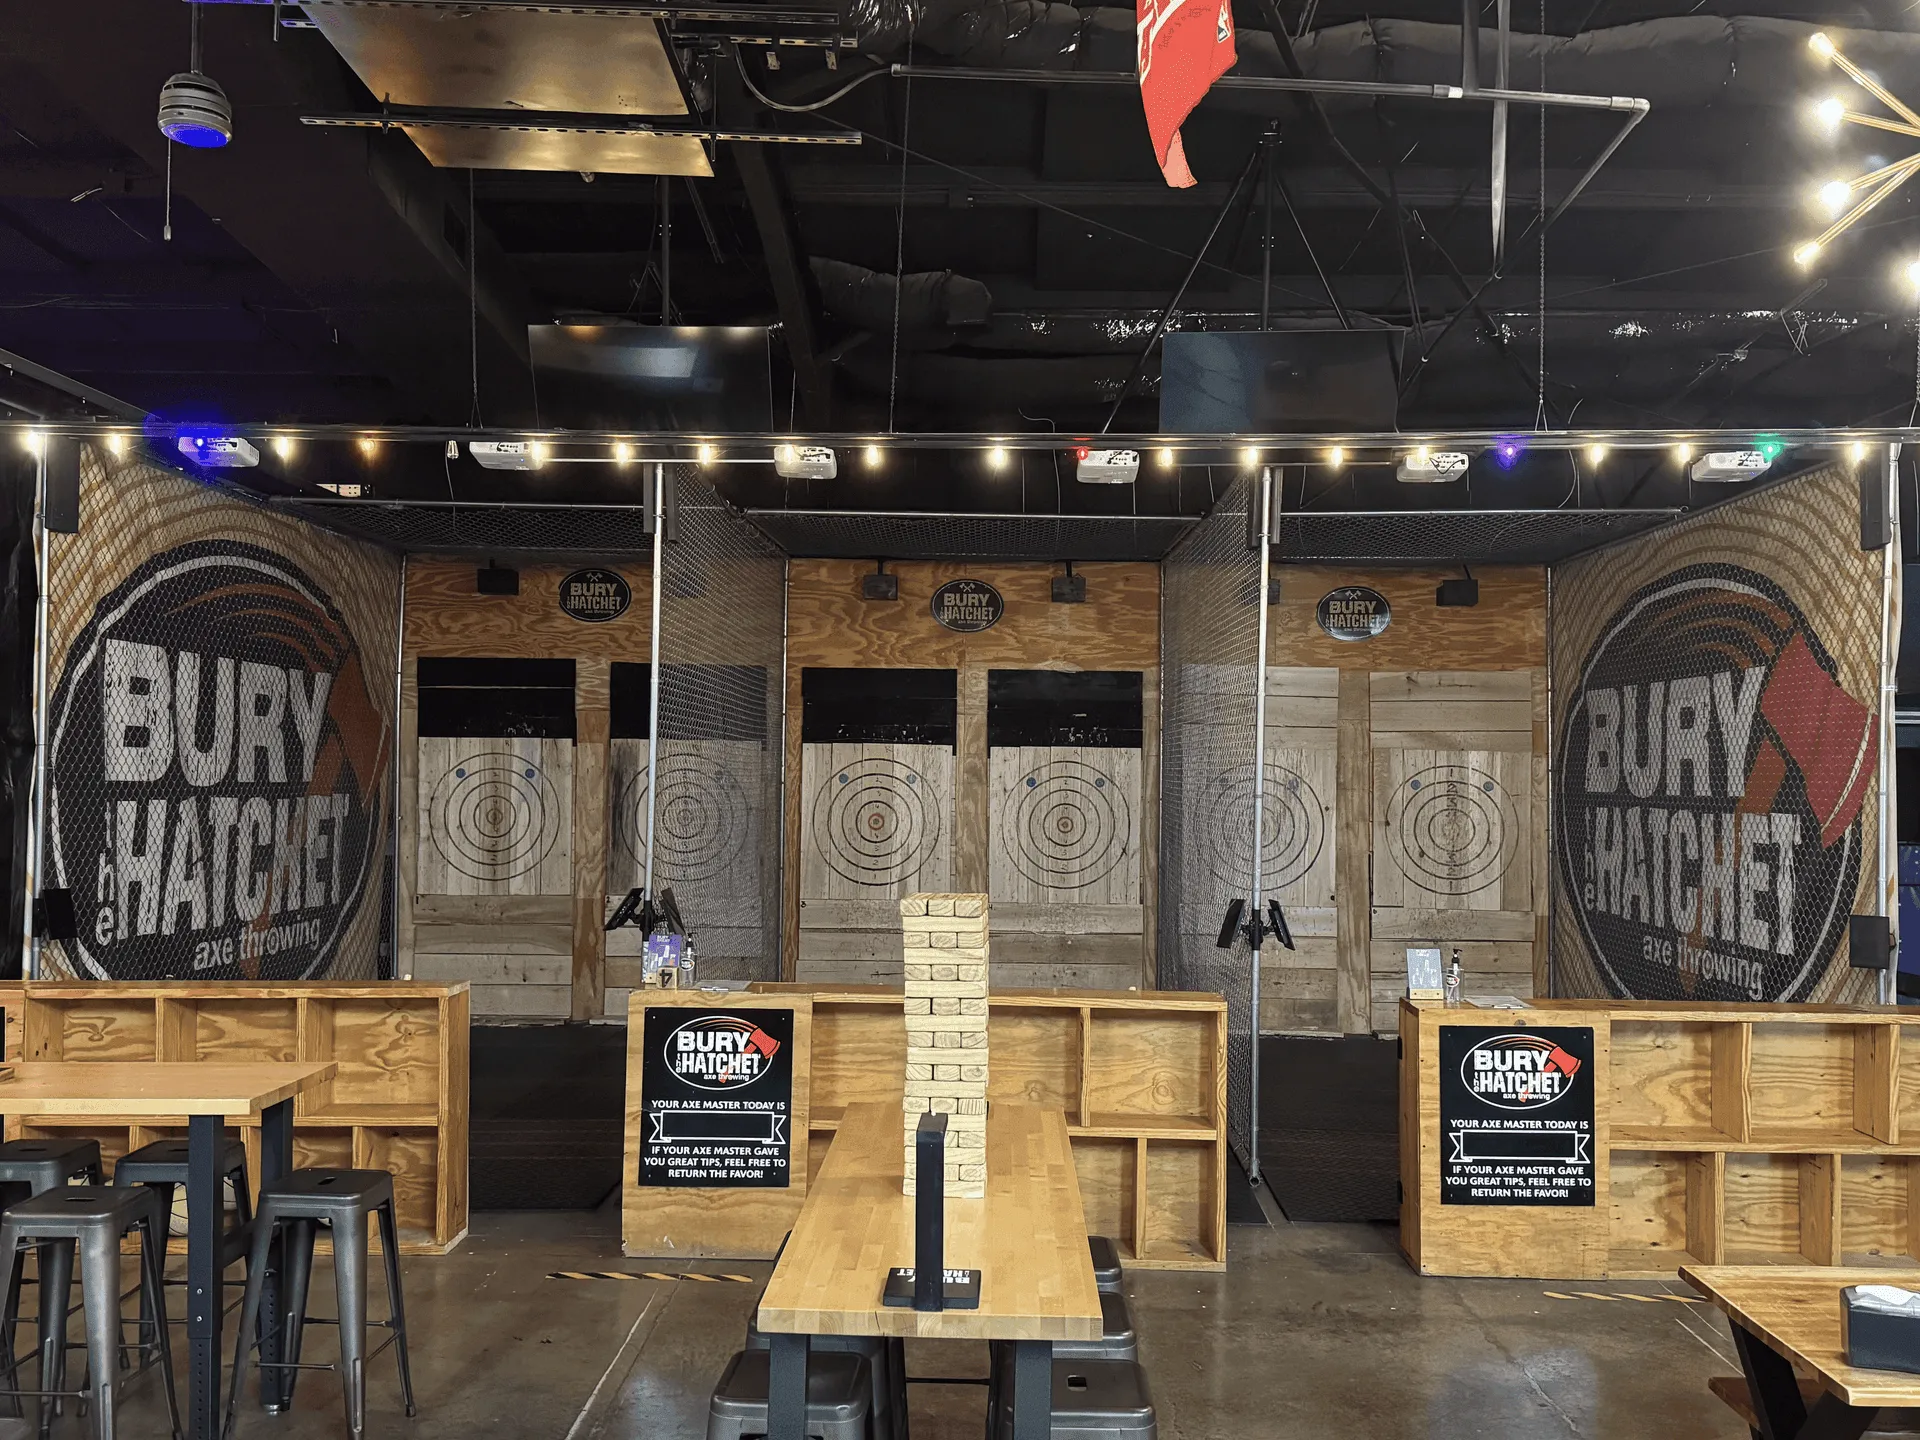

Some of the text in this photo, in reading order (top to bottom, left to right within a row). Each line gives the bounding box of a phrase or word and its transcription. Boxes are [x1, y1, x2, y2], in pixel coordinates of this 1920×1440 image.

[570, 583, 617, 596] BURY
[571, 596, 621, 610] HATCHET
[944, 593, 990, 606] BURY
[944, 607, 994, 620] HATCHET
[1329, 601, 1377, 614] BURY
[104, 638, 333, 787] BURY
[1585, 666, 1766, 798] BURY
[116, 793, 350, 941] HATCHET
[1595, 806, 1801, 956] HATCHET
[194, 915, 321, 971] axe throwing
[1643, 935, 1763, 1000] axe throwing
[677, 1031, 751, 1052] BURY
[681, 1052, 761, 1074] HATCHET
[1473, 1050, 1550, 1071] BURY
[718, 1073, 750, 1082] throwing
[1480, 1071, 1561, 1093] HATCHET
[1518, 1093, 1550, 1101] throwing
[652, 1100, 785, 1110] YOUR AXE MASTER TODAY IS
[1450, 1119, 1589, 1129] YOUR AXE MASTER TODAY IS
[651, 1146, 779, 1156] IF YOUR AXE MASTER GAVE
[644, 1157, 786, 1168] YOU GREAT TIPS, FEEL FREE TO
[668, 1169, 763, 1178] RETURN THE FAVOR!
[1452, 1165, 1584, 1175] IF YOUR AXE MASTER GAVE
[1445, 1176, 1591, 1187] YOU GREAT TIPS, FEEL FREE TO
[1471, 1188, 1569, 1197] RETURN THE FAVOR!
